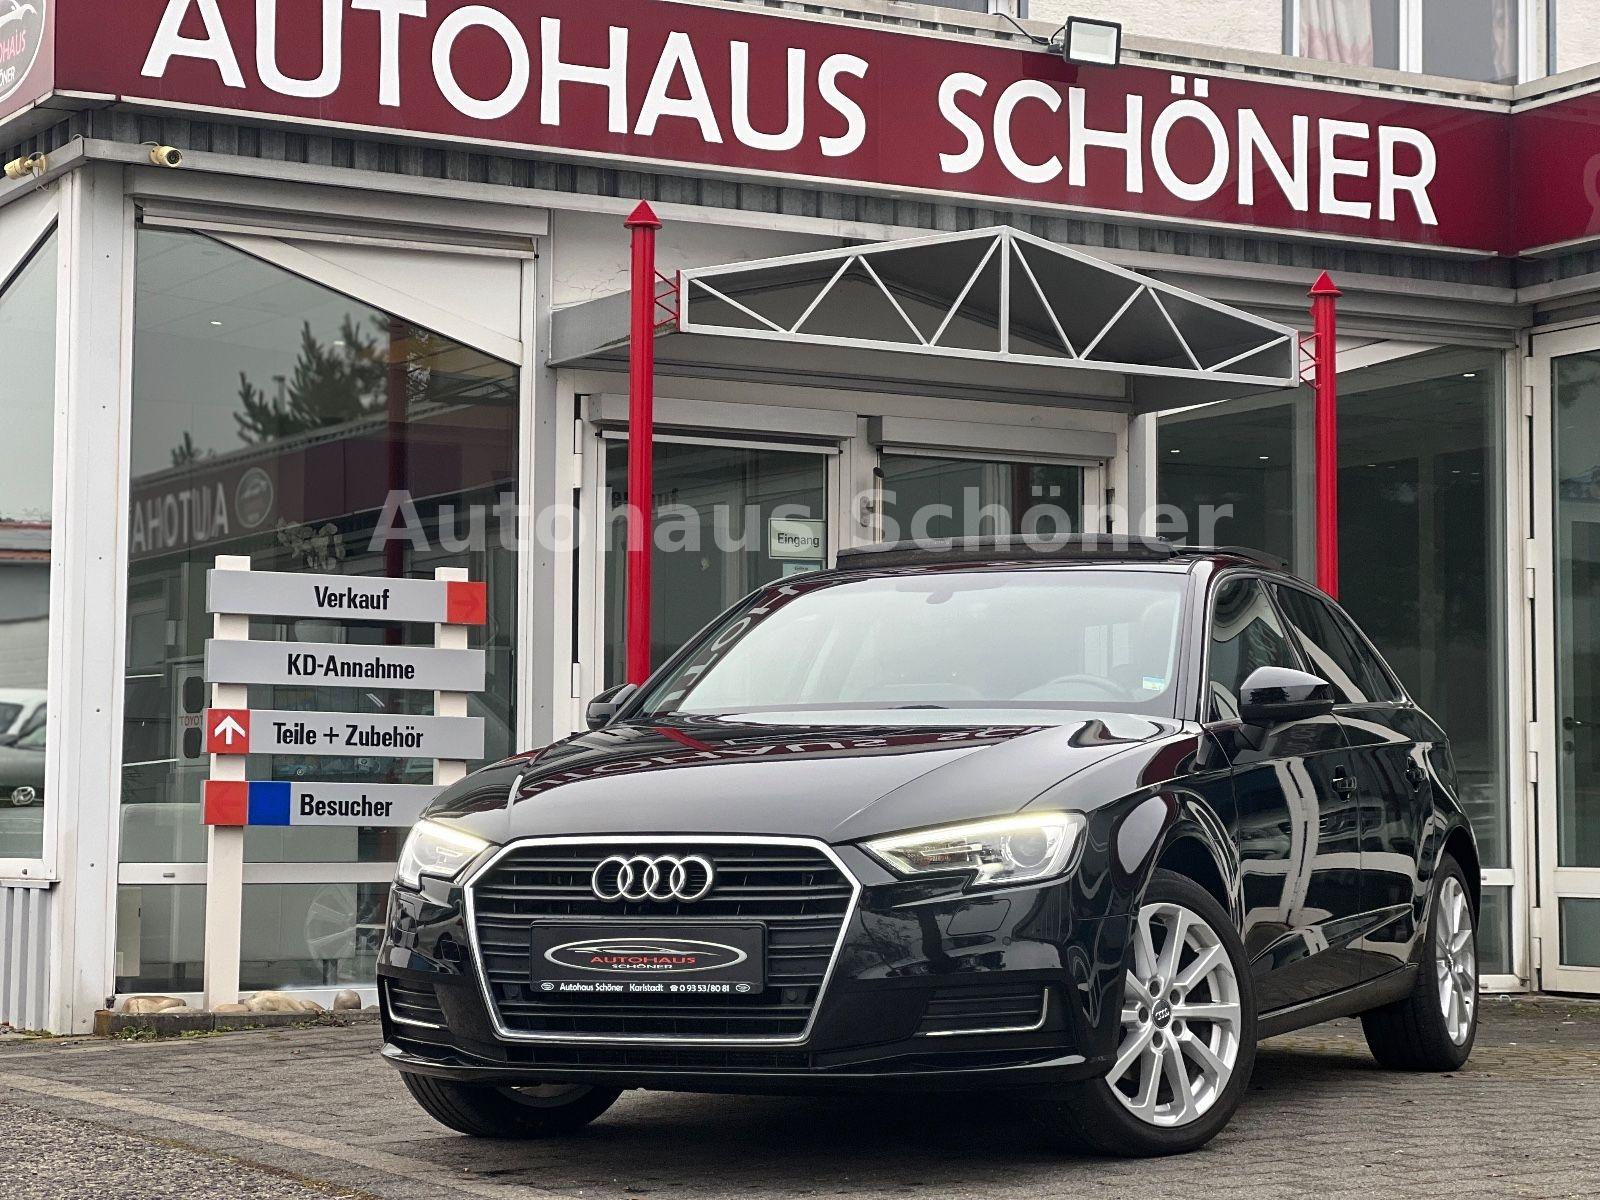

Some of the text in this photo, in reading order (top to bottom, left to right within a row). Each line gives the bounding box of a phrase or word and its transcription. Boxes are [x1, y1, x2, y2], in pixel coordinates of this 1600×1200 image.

[141, 0, 1438, 225] AUTOHAUS SCHÖNER
[777, 532, 820, 548] Eingang
[314, 586, 390, 611] Verkauf
[287, 653, 415, 680] KD-Annahme
[273, 721, 317, 746] Teile
[345, 724, 424, 748] Zubehör
[300, 793, 393, 817] Besucher
[590, 955, 696, 964] AUTOHAUS
[559, 982, 593, 991] Autohaus
[595, 982, 624, 992] Schöner
[629, 983, 664, 992] Karlstadt
